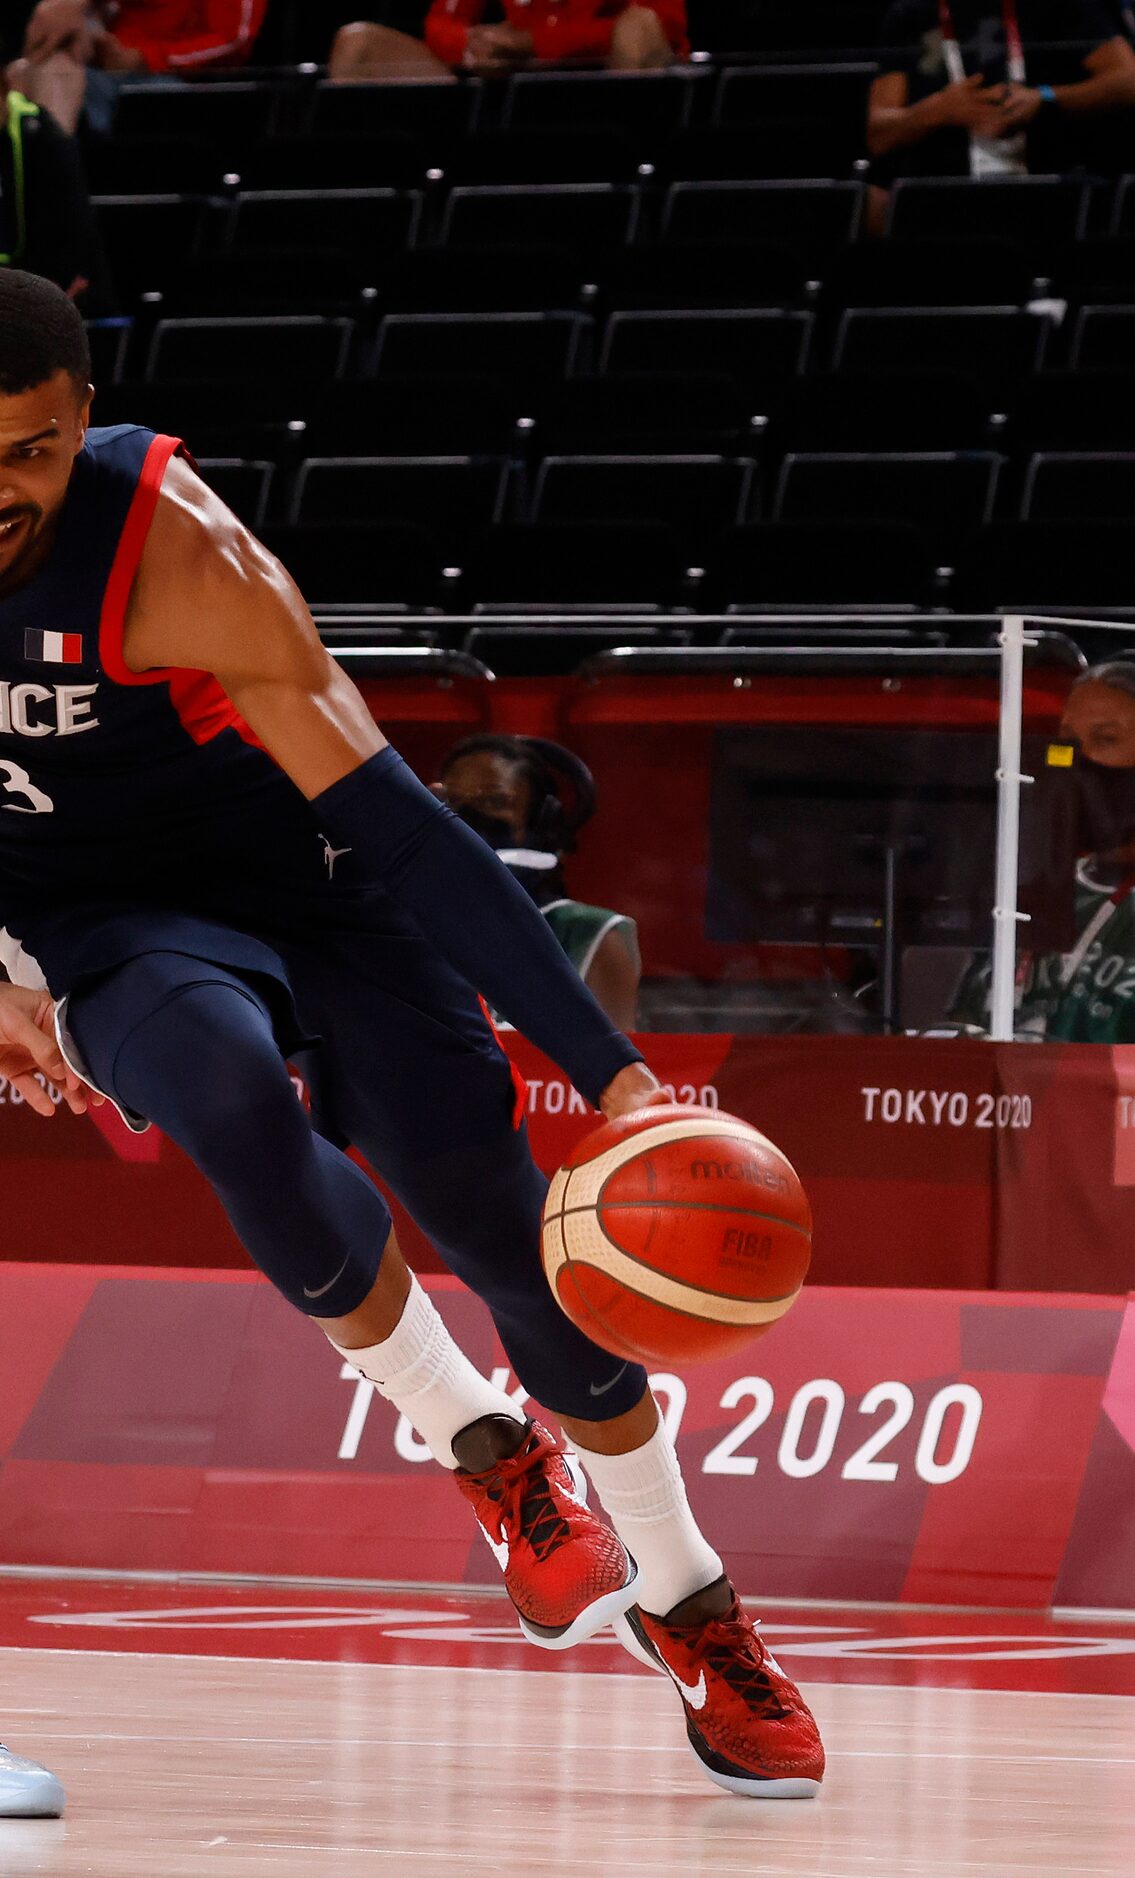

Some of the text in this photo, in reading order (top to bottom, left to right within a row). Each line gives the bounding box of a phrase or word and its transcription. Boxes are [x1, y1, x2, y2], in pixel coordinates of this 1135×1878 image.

[861, 1087, 1032, 1129] TOKYO 2020
[721, 1227, 773, 1260] FIBA
[701, 1375, 983, 1484] 2020
